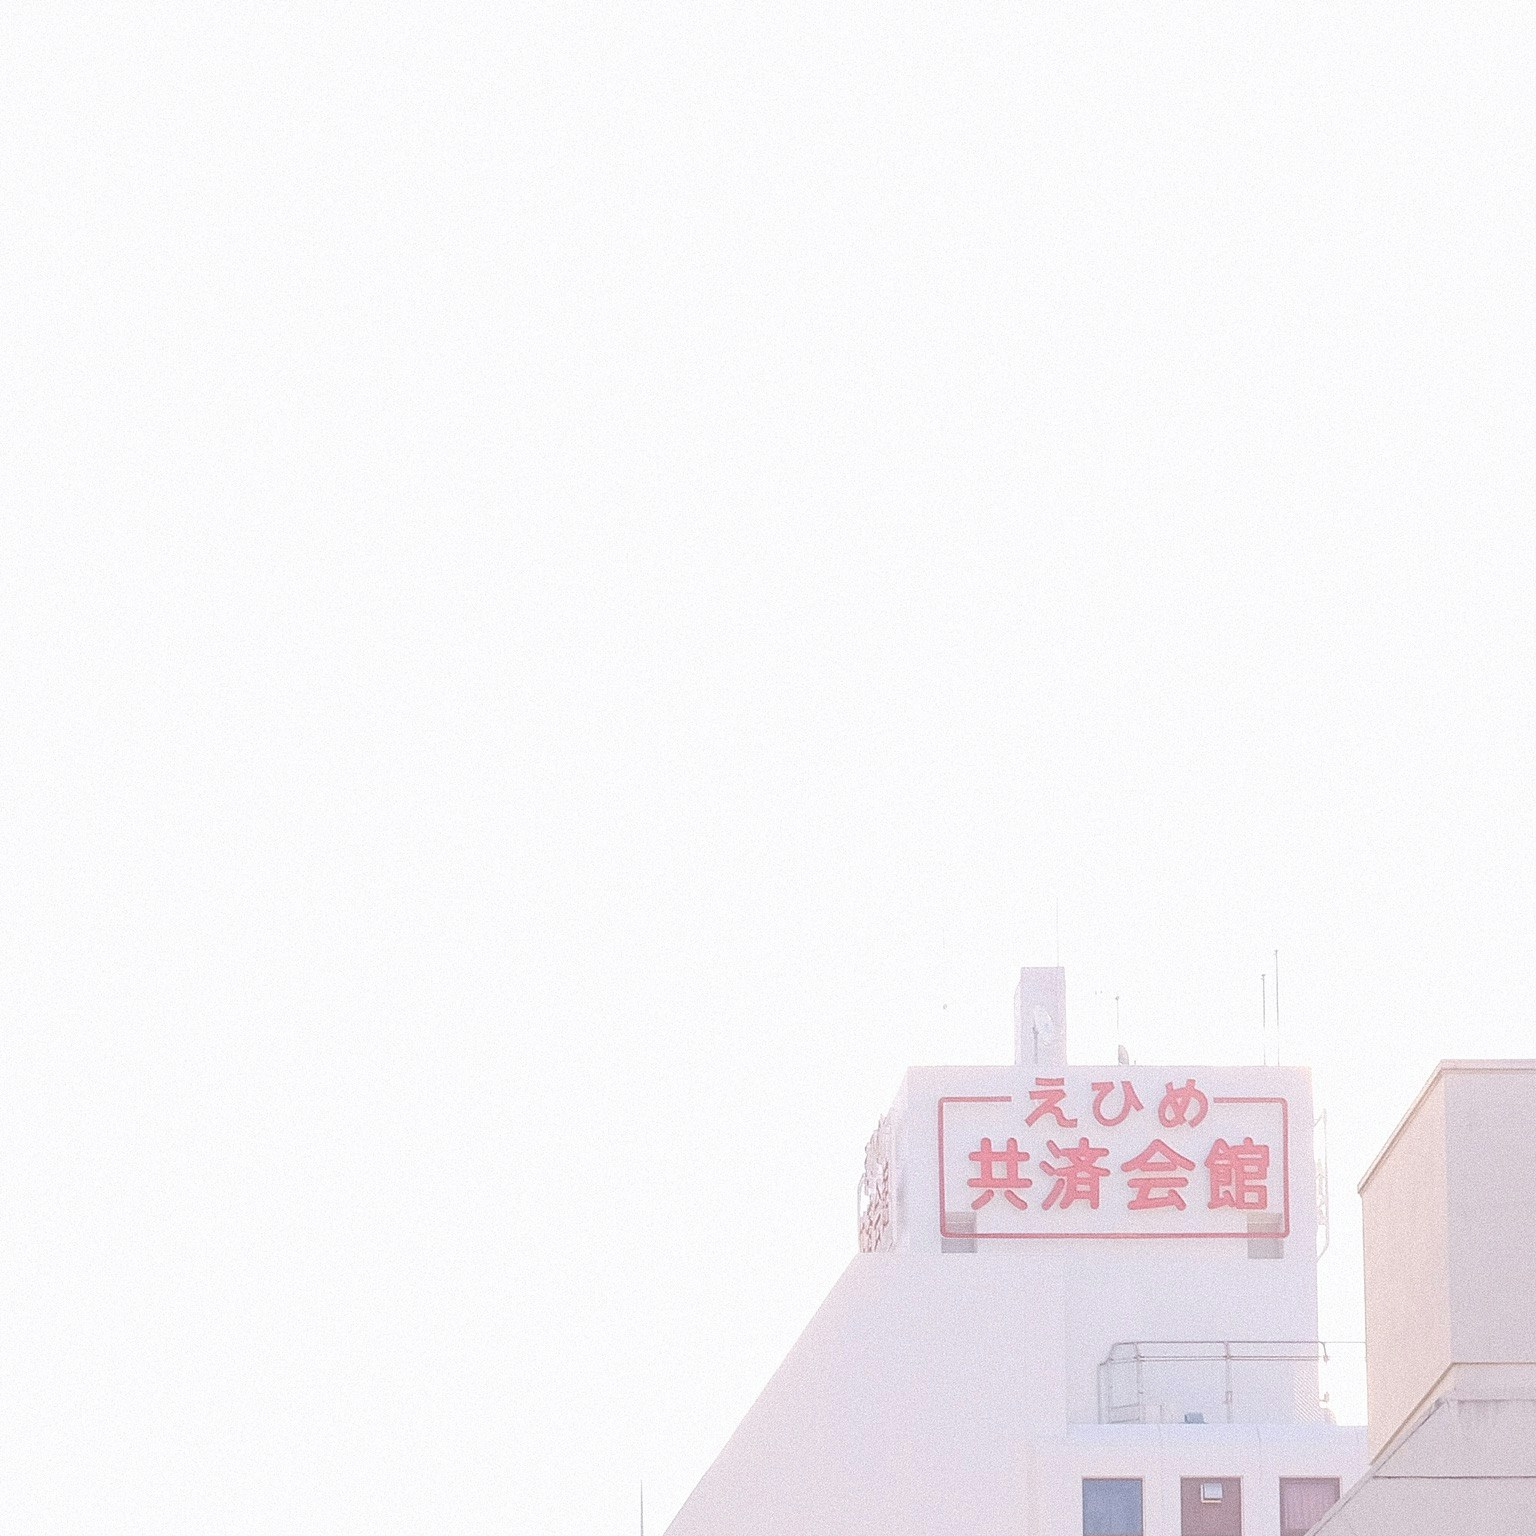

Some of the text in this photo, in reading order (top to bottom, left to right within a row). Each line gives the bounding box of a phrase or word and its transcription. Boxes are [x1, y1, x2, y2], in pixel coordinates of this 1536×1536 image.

[1024, 1077, 1209, 1129] えひめ
[967, 1136, 1271, 1210] 共済会館
